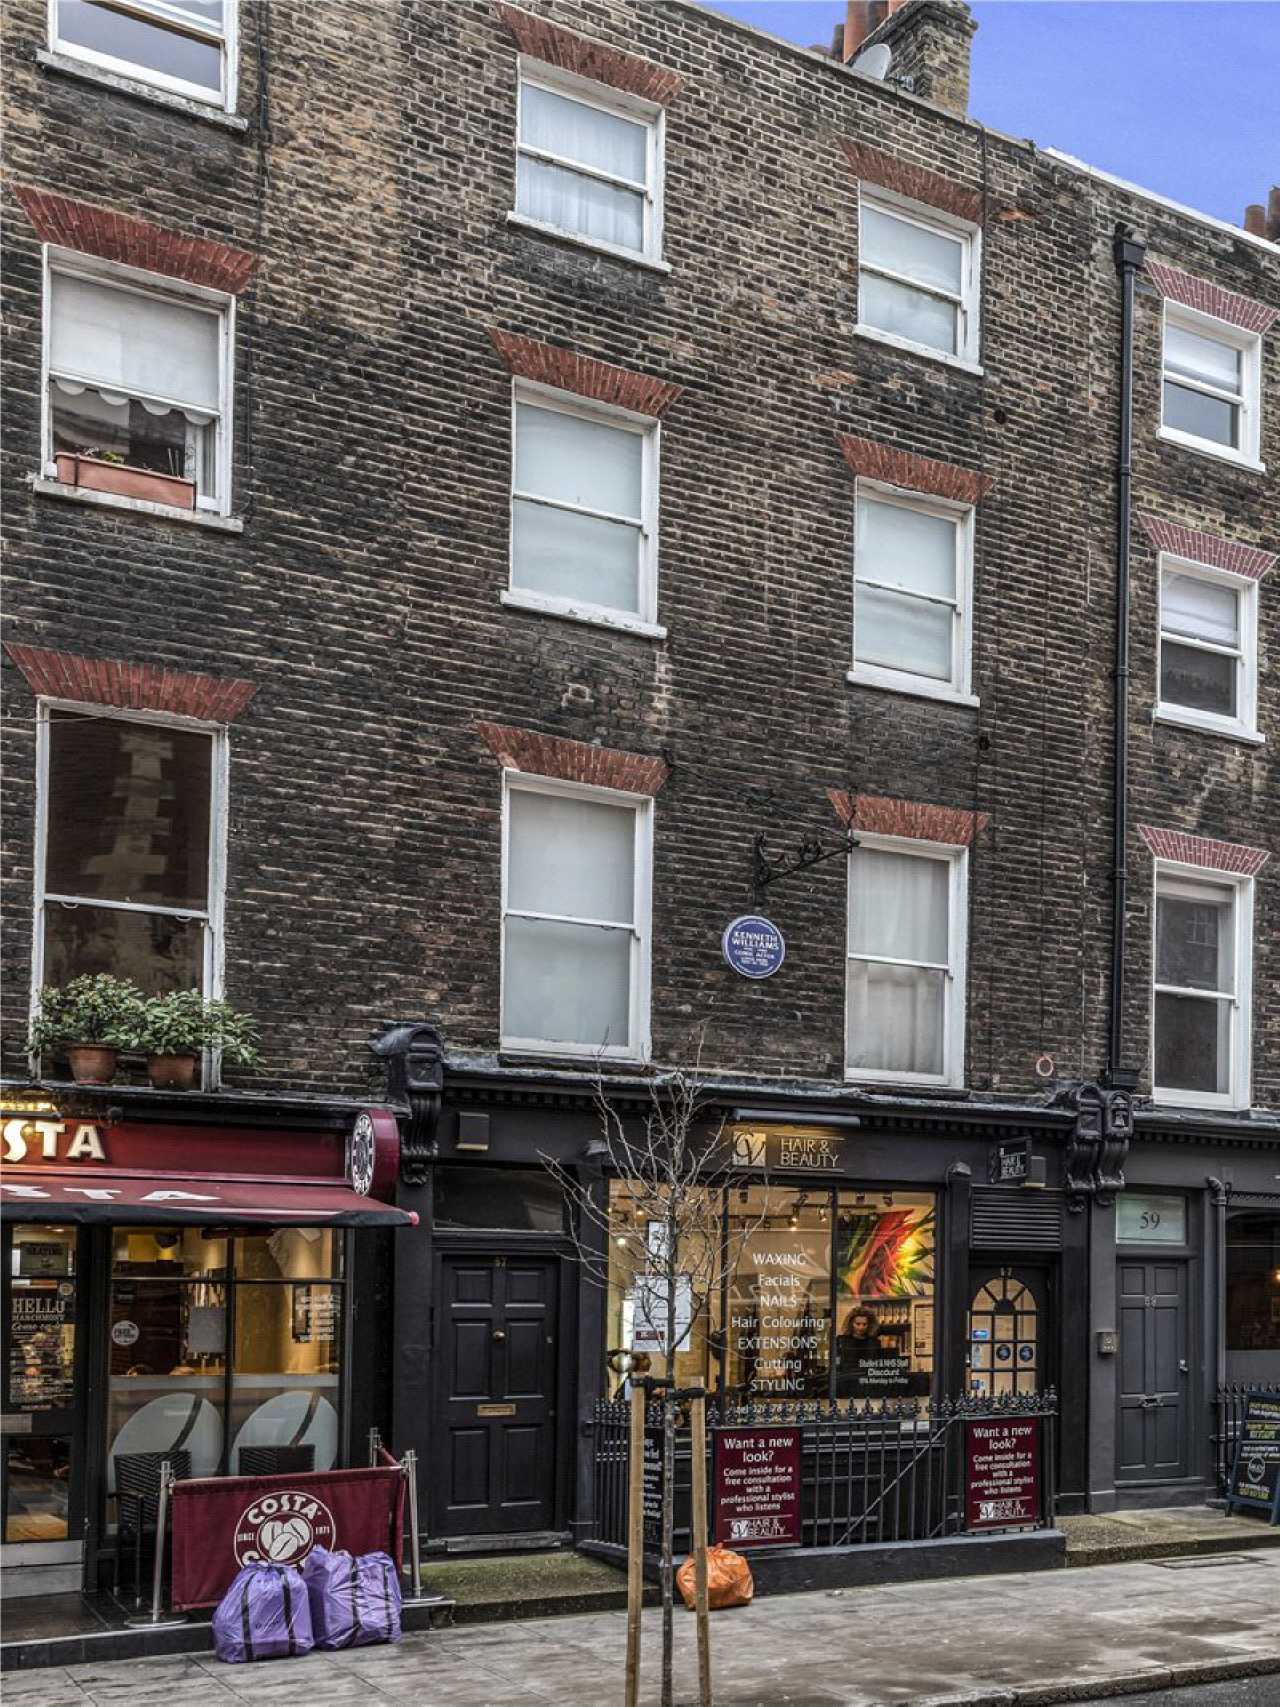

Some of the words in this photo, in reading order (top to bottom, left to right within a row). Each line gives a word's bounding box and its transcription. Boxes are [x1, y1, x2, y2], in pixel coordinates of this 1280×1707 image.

[733, 931, 778, 942] KENNETH
[732, 938, 779, 950] WILLIAMS
[781, 1138, 815, 1153] HAIR
[820, 1140, 831, 1154] &
[781, 1153, 840, 1168] BEAUTY
[1140, 1211, 1160, 1231] 59
[752, 1253, 807, 1266] WAXING
[759, 1274, 801, 1287] Facials
[760, 1295, 797, 1308] NAILS
[731, 1316, 758, 1328] Hair
[762, 1315, 825, 1330] Colouring
[738, 1336, 818, 1350] EXTENSIONS
[754, 1358, 802, 1373] Cutting
[750, 1379, 805, 1392] STYLING
[973, 1427, 1000, 1438] Want
[1002, 1428, 1009, 1437] a
[1011, 1427, 1033, 1437] new
[724, 1438, 754, 1450] Want
[759, 1439, 765, 1448] a
[768, 1438, 794, 1448] new
[989, 1438, 1017, 1450] look?
[743, 1450, 774, 1462] look?
[972, 1454, 994, 1463] Come
[723, 1467, 747, 1477] Come
[748, 1466, 772, 1475] inside
[774, 1465, 785, 1473] for
[725, 1477, 741, 1486] free
[743, 1475, 792, 1485] consultation
[746, 1485, 764, 1493] with
[720, 1493, 769, 1505] professional
[247, 1494, 319, 1525] COSTA
[736, 1503, 753, 1512] who
[755, 1502, 780, 1511] listens
[749, 1526, 786, 1536] BEAUTY
